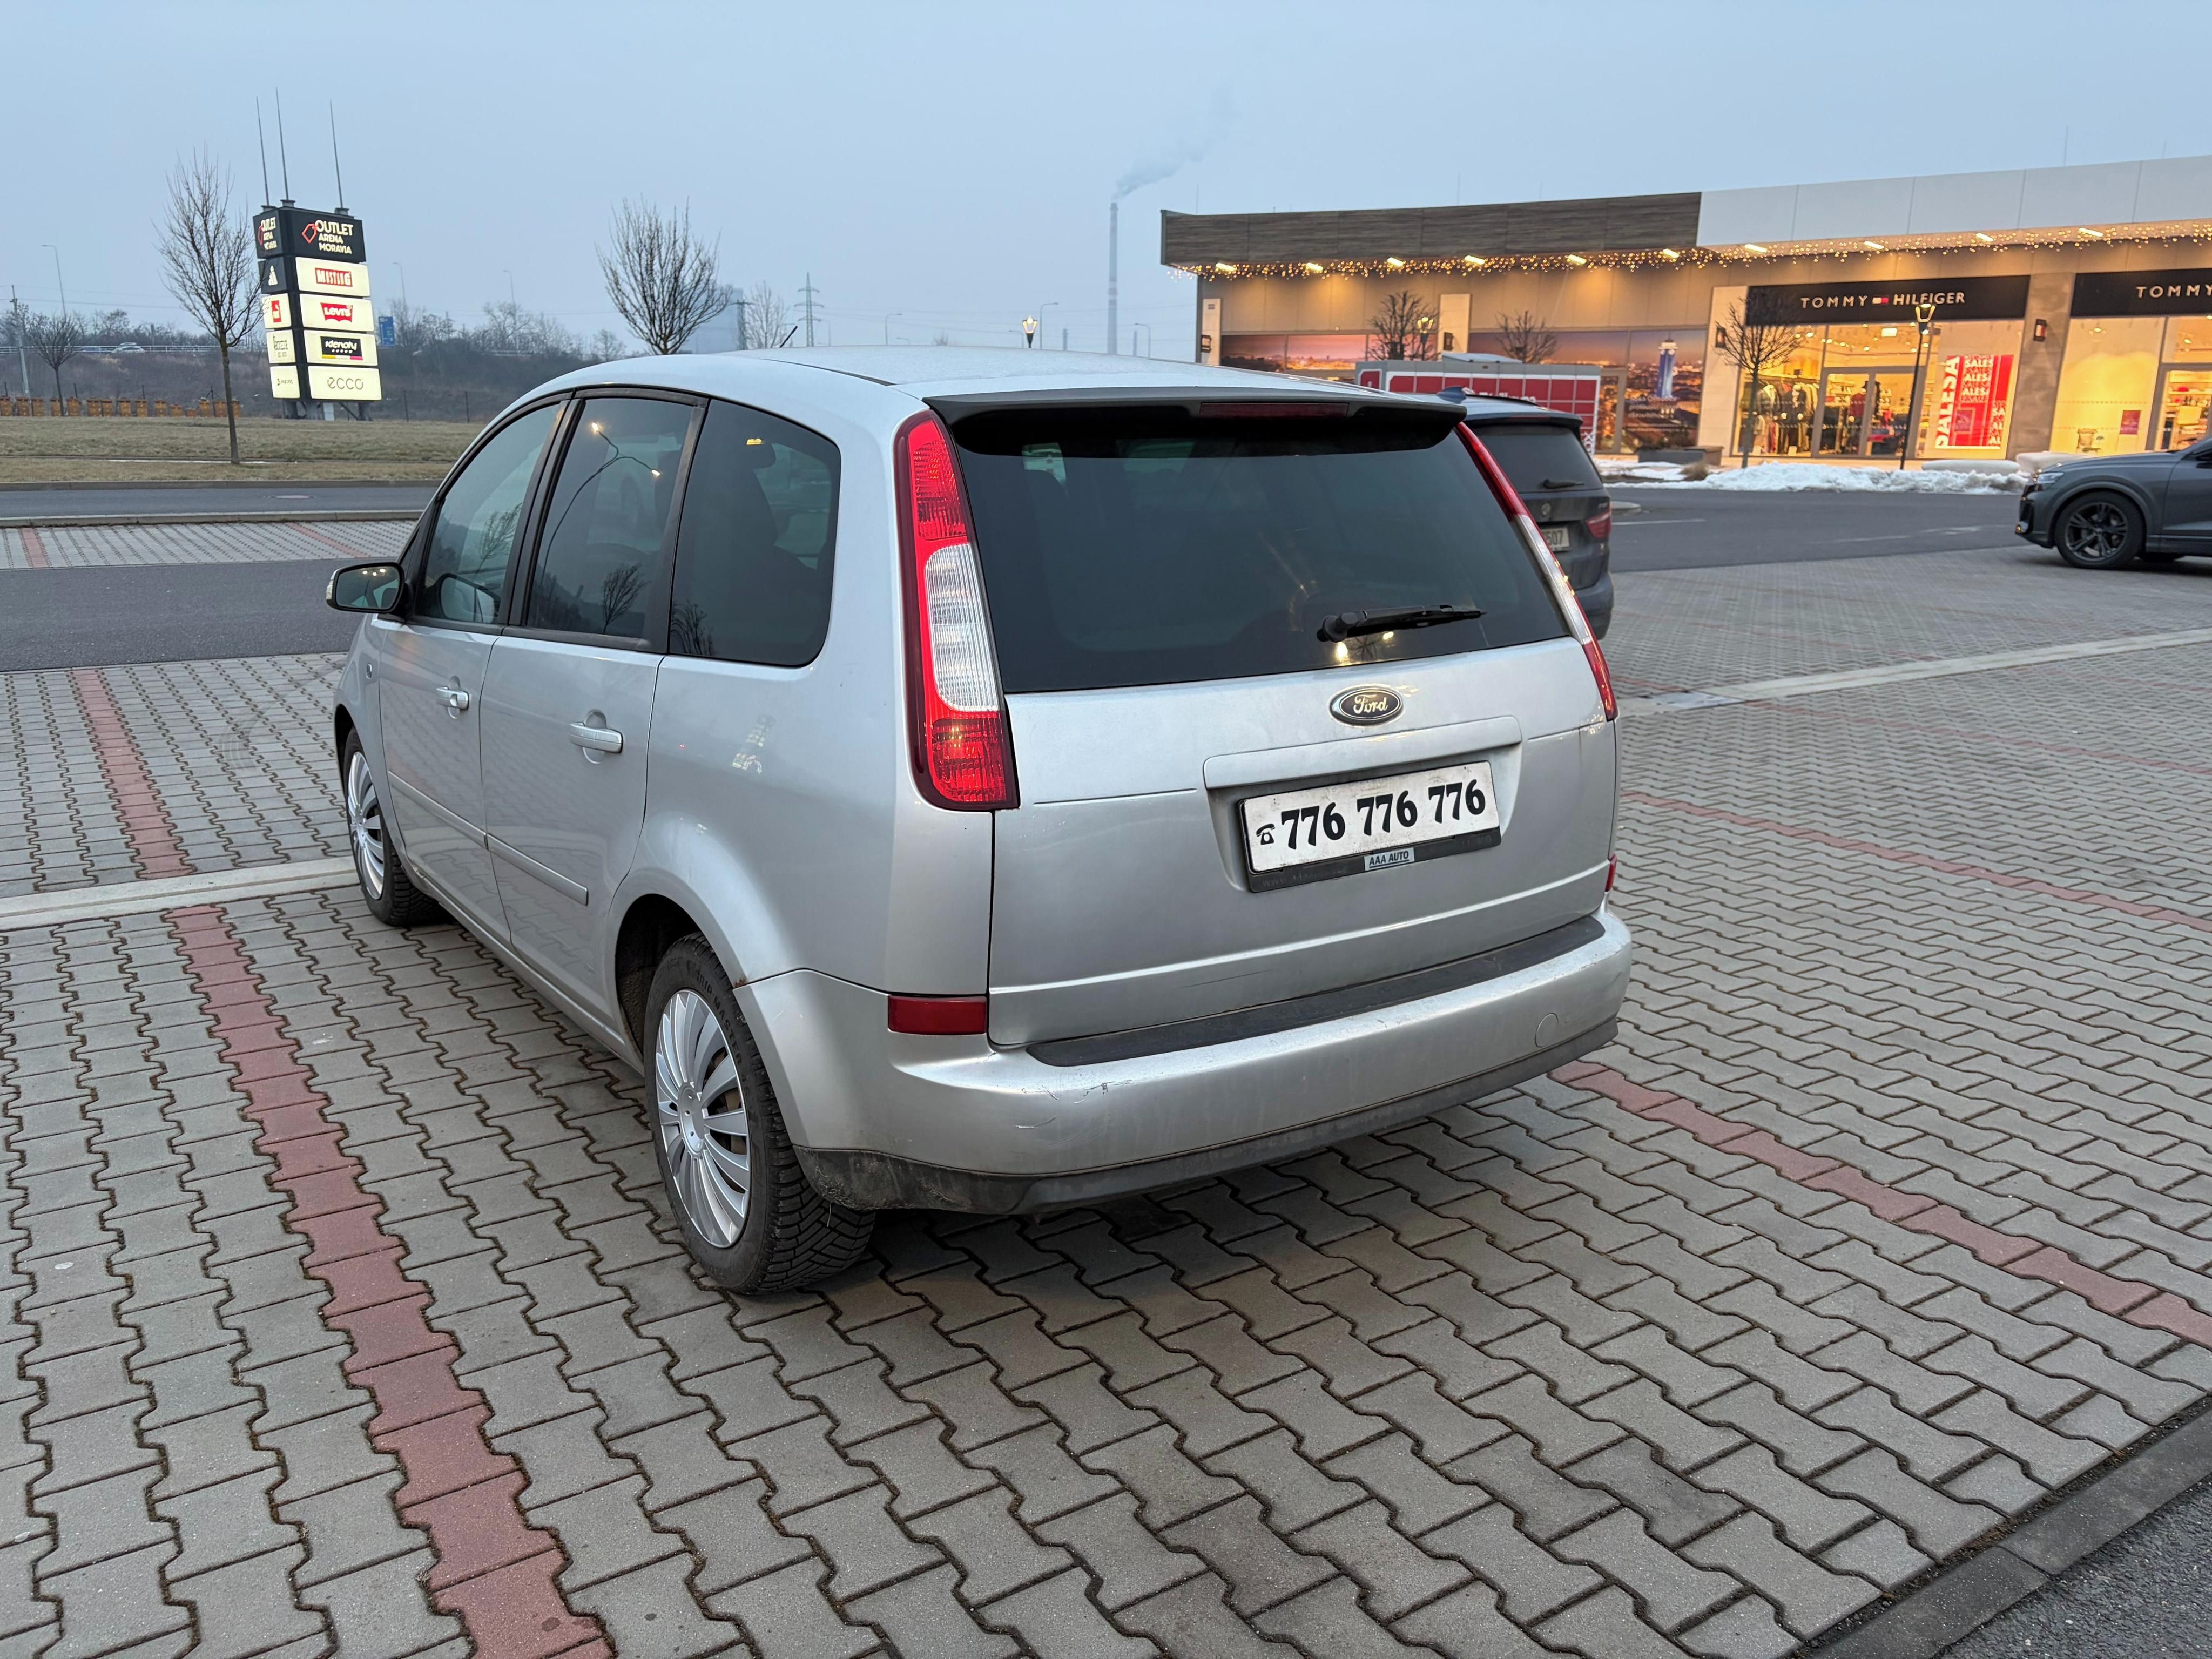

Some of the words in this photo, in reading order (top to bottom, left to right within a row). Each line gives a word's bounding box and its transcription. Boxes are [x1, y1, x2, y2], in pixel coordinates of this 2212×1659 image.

[315, 220, 354, 236] OUTLET
[319, 233, 343, 244] ARENA
[319, 242, 352, 254] MORAVIA
[1800, 295, 1867, 308] TOMMY
[1893, 292, 1965, 305] HILFIGER
[327, 377, 363, 390] ecco
[1353, 694, 1388, 714] Ford
[1281, 802, 1345, 850] 776
[1357, 790, 1418, 836] 776
[1428, 779, 1486, 824] 776
[1369, 855, 1386, 866] AAA
[1388, 851, 1409, 862] AUTO
